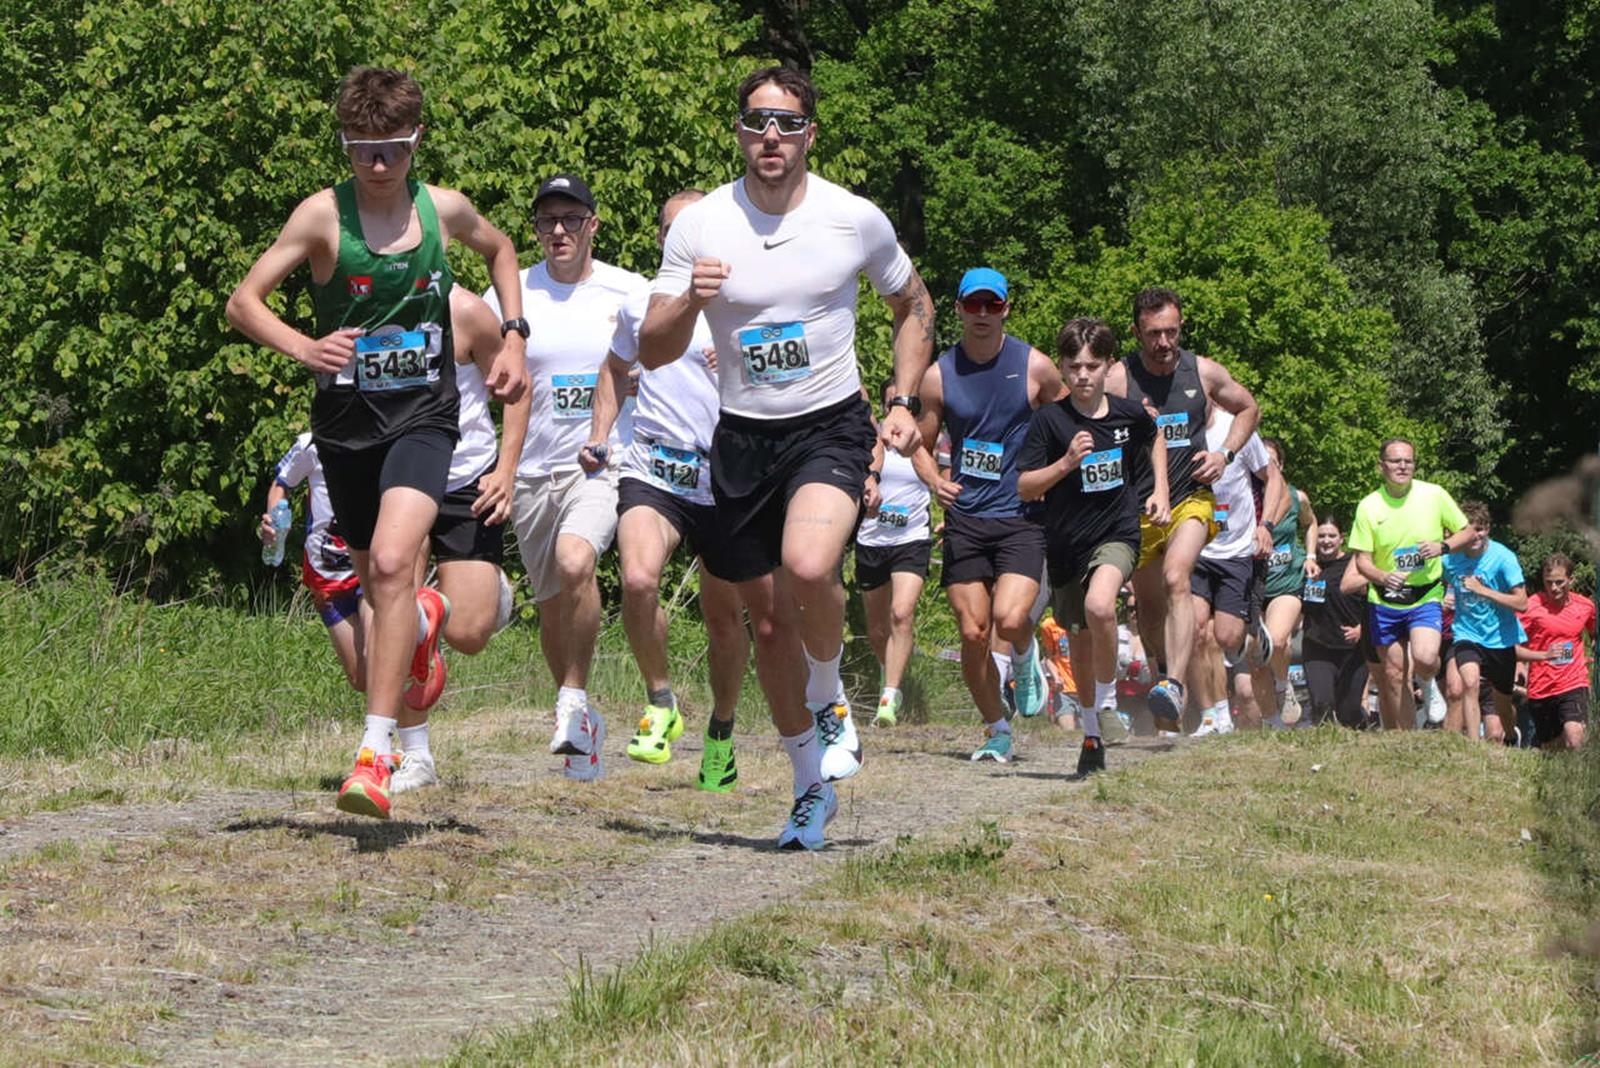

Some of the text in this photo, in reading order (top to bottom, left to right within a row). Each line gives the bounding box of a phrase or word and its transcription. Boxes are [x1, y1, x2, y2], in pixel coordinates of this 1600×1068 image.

[364, 350, 419, 379] 543
[749, 340, 801, 373] 548
[557, 387, 595, 409] 527
[1160, 423, 1184, 441] 04
[654, 459, 693, 485] 512
[965, 450, 996, 472] 578
[1086, 461, 1119, 484] 654
[1398, 553, 1421, 568] 620
